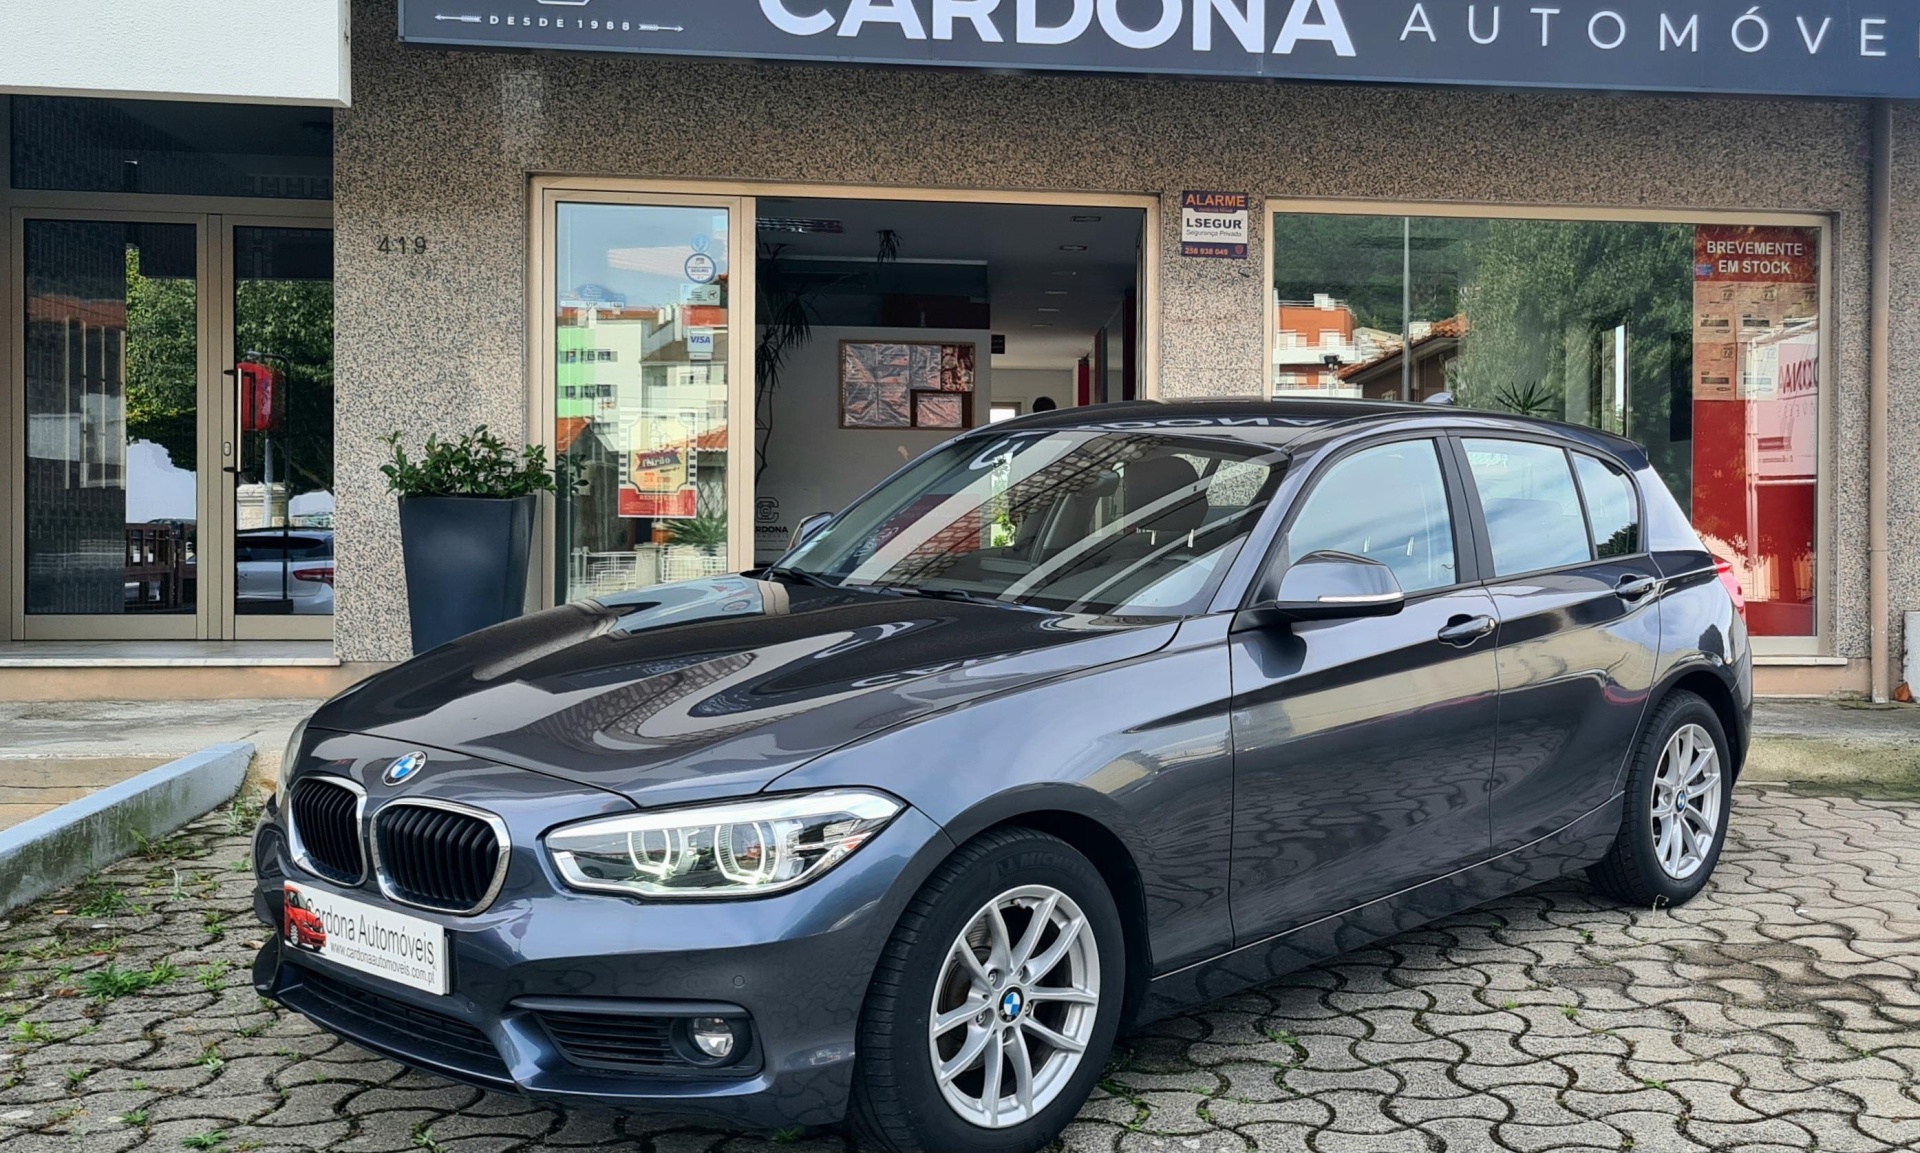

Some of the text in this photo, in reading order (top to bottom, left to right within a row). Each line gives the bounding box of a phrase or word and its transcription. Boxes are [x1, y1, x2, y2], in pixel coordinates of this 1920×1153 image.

[489, 15, 630, 31] DESDE 1988
[1399, 3, 1920, 57] AUTOMÓVE
[1185, 193, 1246, 207] ALARME
[1186, 217, 1242, 230] LSEGUR
[1186, 229, 1242, 238] Segurança Privada
[377, 236, 427, 255] 419
[1706, 240, 1803, 256] BREVEMENTE
[1718, 260, 1791, 274] EM STOCK
[689, 336, 711, 344] VISA
[305, 898, 435, 966] Cardona Automóveis
[330, 941, 436, 986] www.cardonaautomoveis.com.pt
